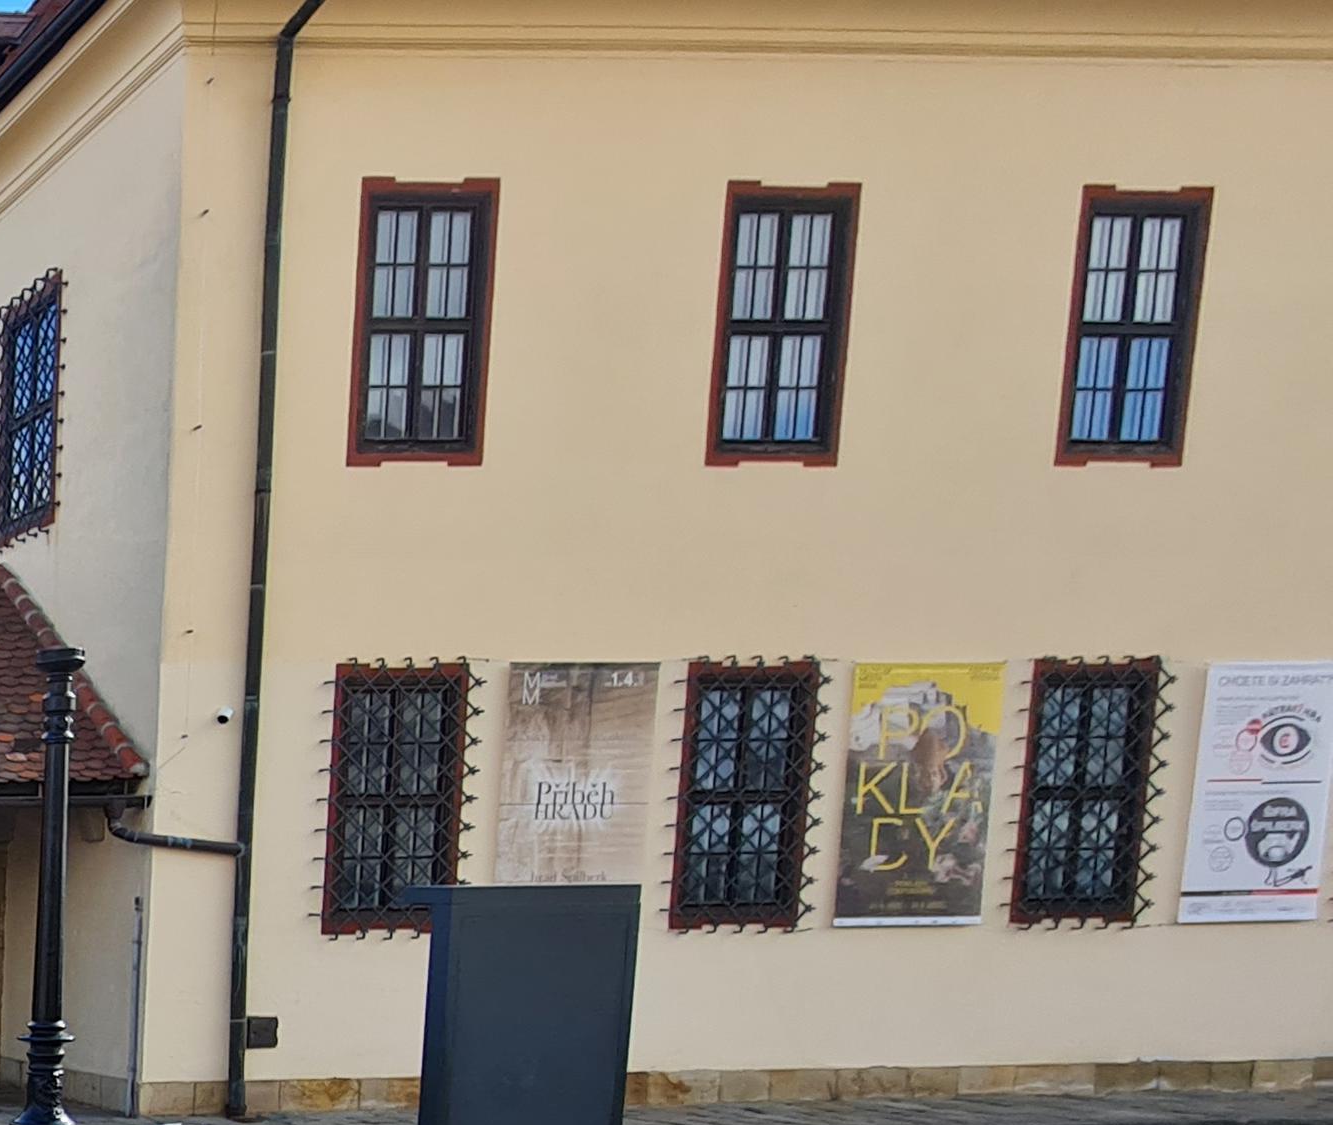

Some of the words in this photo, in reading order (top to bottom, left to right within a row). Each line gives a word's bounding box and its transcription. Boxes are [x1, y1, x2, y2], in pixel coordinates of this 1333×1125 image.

[536, 780, 615, 806] Příběh
[855, 760, 983, 815] KLA
[534, 802, 614, 821] HRADU
